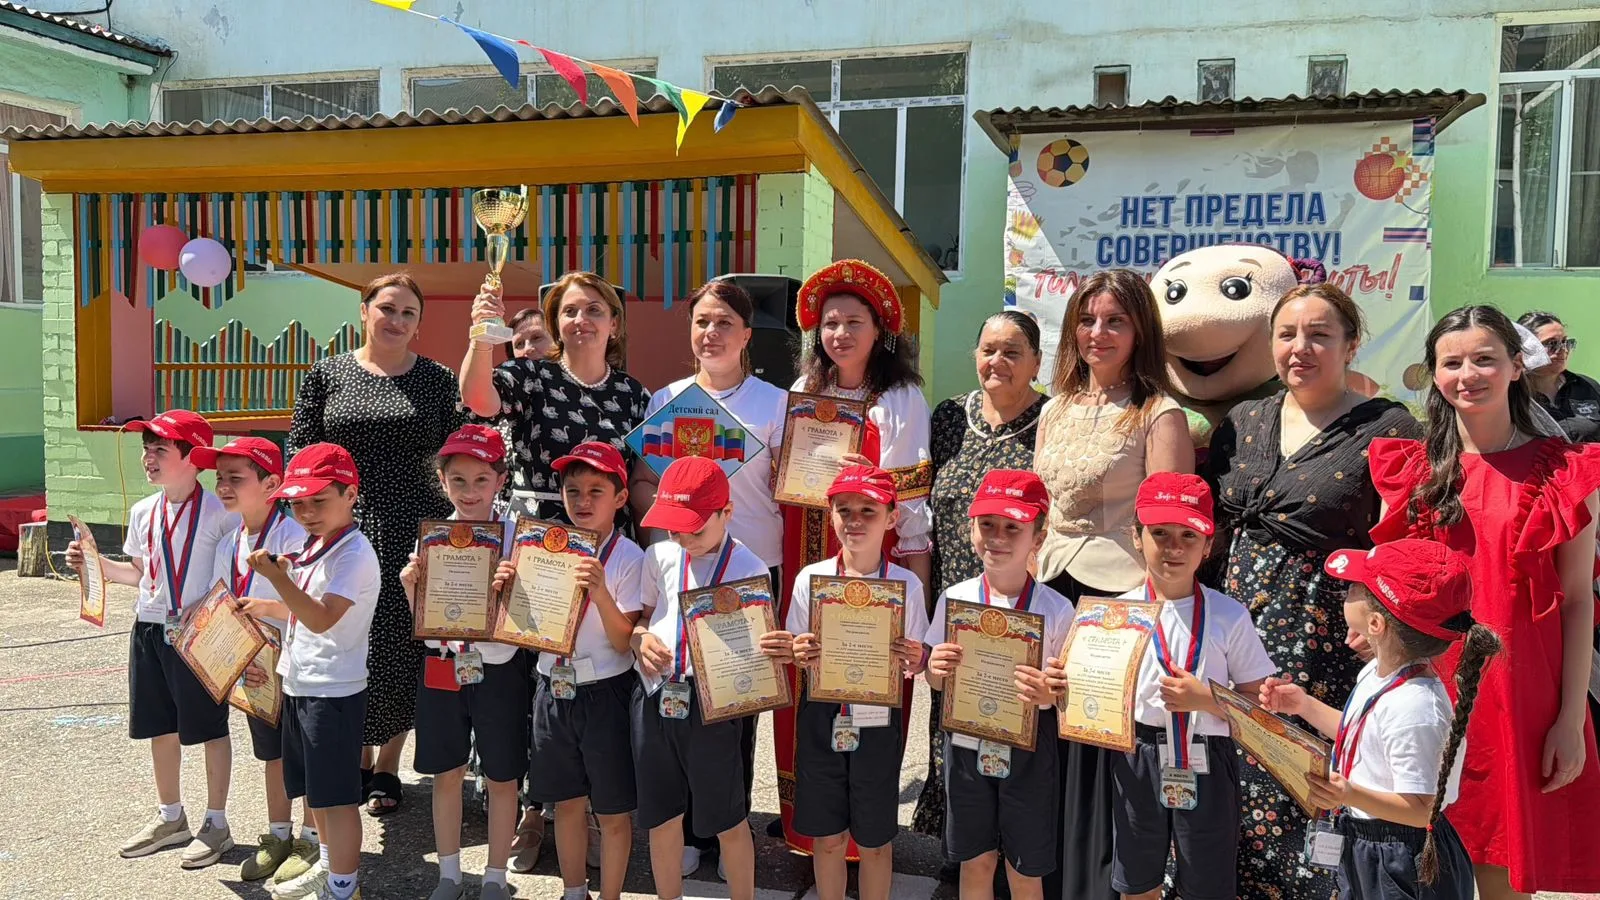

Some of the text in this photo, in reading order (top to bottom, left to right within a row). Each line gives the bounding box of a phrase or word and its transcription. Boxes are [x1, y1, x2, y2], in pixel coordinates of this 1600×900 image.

[1120, 192, 1326, 228] НЕТ ПРЕДЕЛА
[668, 404, 703, 415] Детский
[807, 426, 838, 437] ГРАМОТА
[252, 448, 273, 465] RUSSIA
[442, 554, 475, 562] ГРАМОТА
[533, 556, 566, 569] ГРАМОТА
[1375, 575, 1400, 606] RUSSIA
[714, 617, 749, 631] ГРАМОТА
